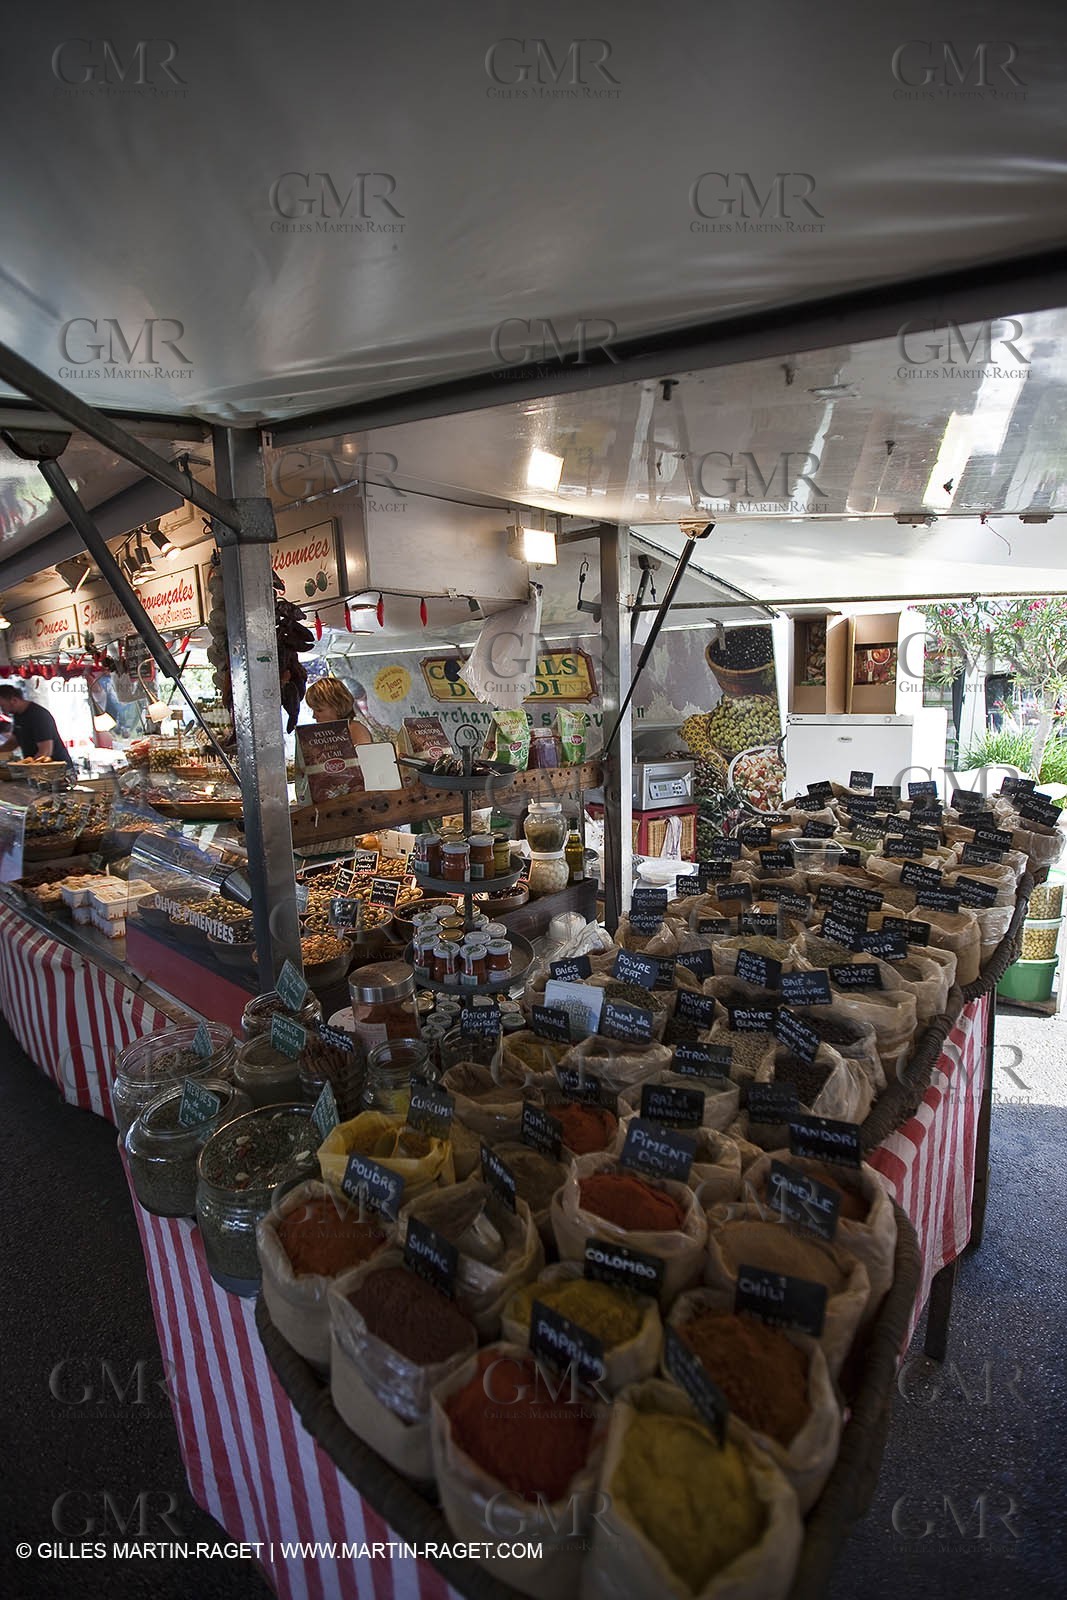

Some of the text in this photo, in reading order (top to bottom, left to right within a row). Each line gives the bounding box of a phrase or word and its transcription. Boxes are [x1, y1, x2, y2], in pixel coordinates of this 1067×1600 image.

[35, 618, 69, 638] Douces
[903, 866, 920, 876] ANIS
[678, 878, 700, 889] CUMIN
[845, 888, 864, 899] ANIS
[154, 893, 181, 919] OLIVES
[780, 895, 806, 906] POIVRE
[862, 943, 895, 955] NOIR
[617, 953, 652, 975] POIVRE
[676, 954, 705, 966] NORA
[554, 963, 579, 976] BAIES
[833, 967, 876, 978] POIVRE
[781, 977, 804, 988] BAIE
[680, 992, 712, 1011] POIVRE
[733, 1009, 773, 1021] POIVRE
[736, 1020, 768, 1030] BLANC
[789, 1122, 858, 1149] TANDORI
[630, 1128, 696, 1166] PIMENT
[350, 1157, 397, 1192] POUDRE
[407, 1234, 449, 1275] SUMAC
[584, 1246, 658, 1281] COLOMBO
[738, 1277, 785, 1302] CHILI
